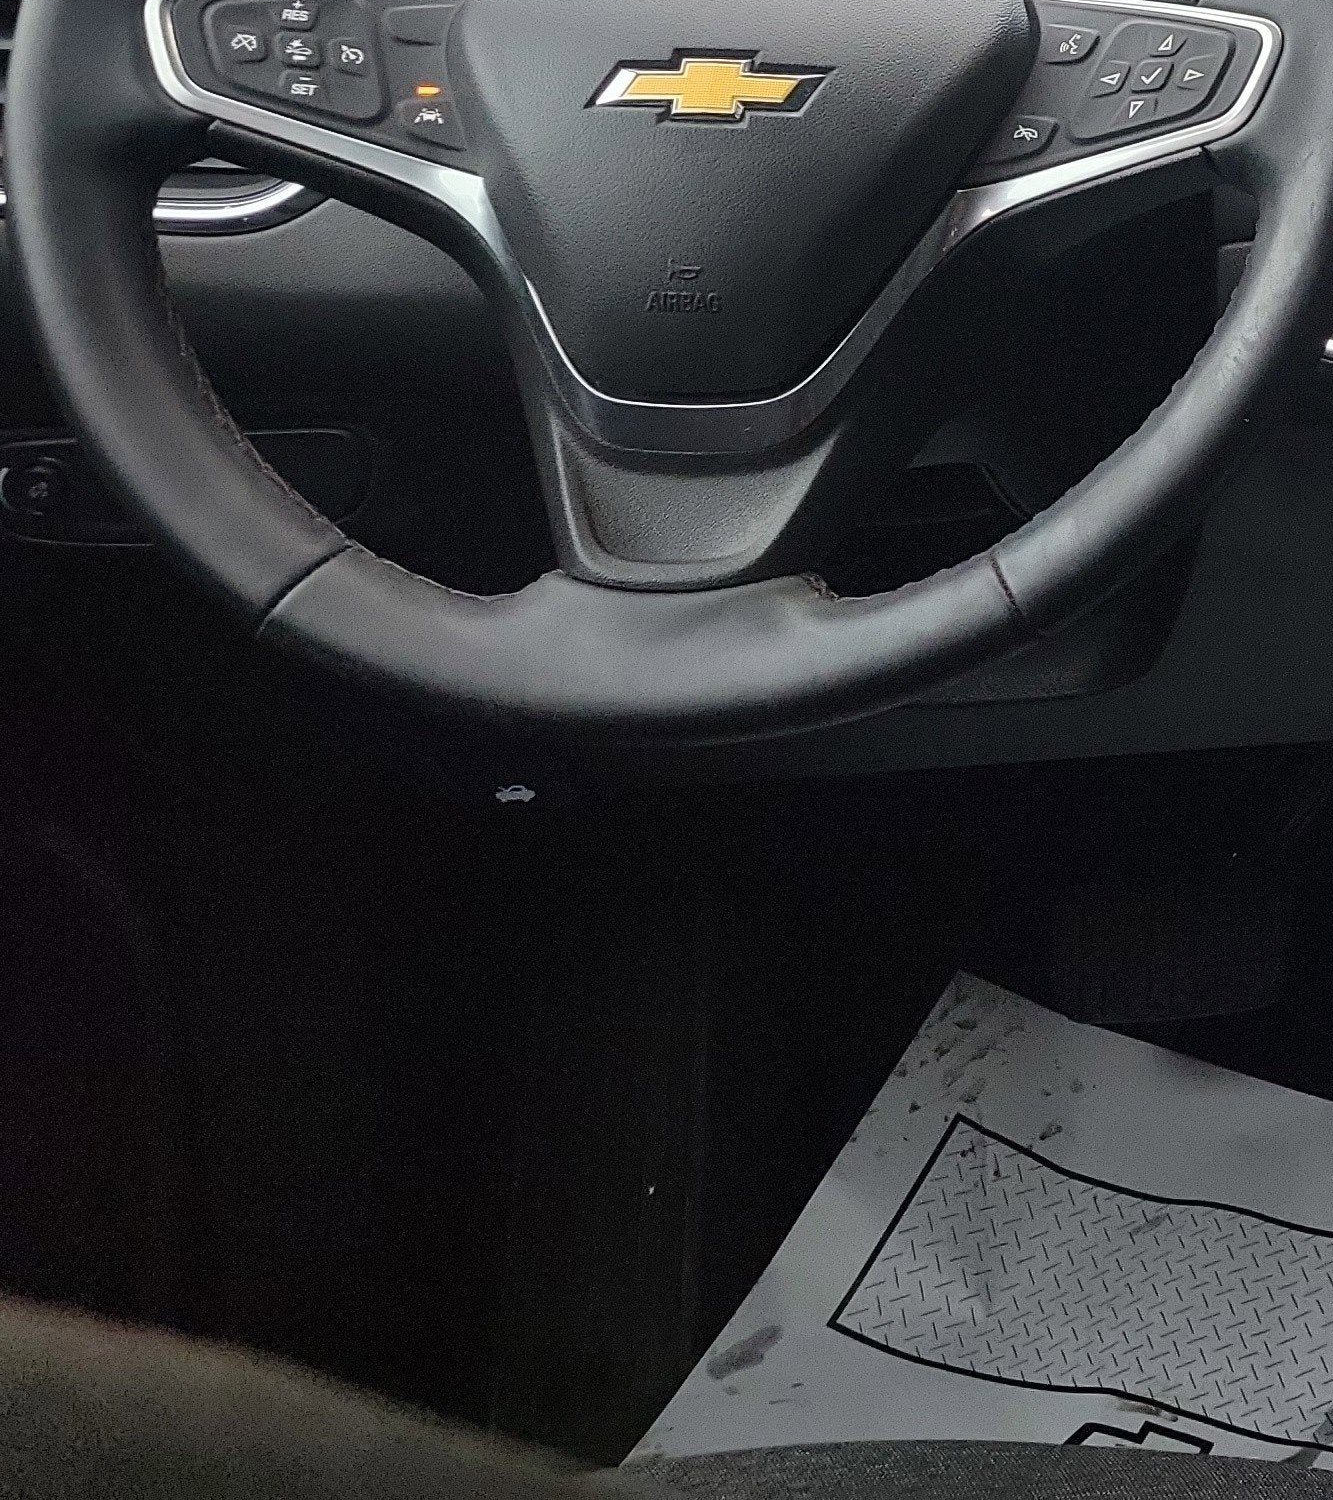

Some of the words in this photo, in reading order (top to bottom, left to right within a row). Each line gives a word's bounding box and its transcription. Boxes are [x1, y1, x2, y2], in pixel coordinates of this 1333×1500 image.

[281, 8, 309, 22] RES
[290, 83, 319, 96] SET
[644, 289, 719, 312] AIRBAG
